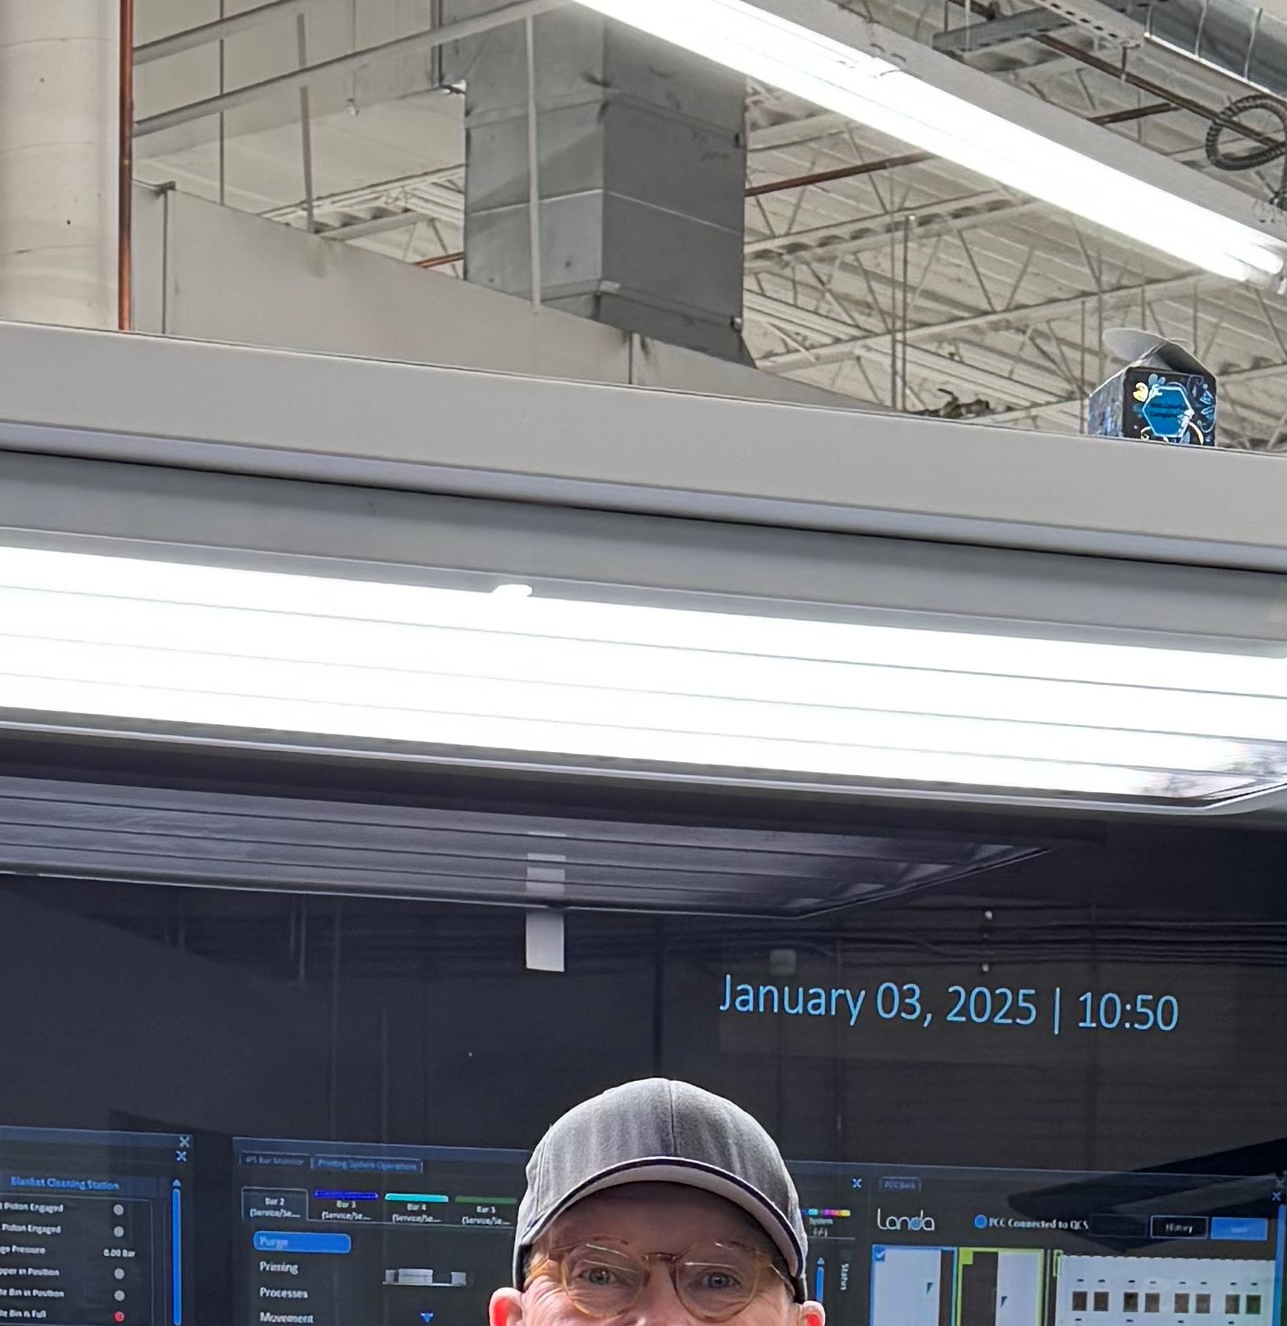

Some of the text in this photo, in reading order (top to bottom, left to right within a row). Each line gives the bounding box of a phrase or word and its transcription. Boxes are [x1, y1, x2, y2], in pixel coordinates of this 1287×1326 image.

[719, 975, 866, 1026] January
[876, 982, 933, 1028] 03,
[946, 986, 1038, 1026] 2025
[1078, 992, 1180, 1032] 10:50
[11, 1176, 119, 1191] Blanket Cleaning Station
[877, 1208, 935, 1231] Landa
[1008, 1218, 1056, 1230] Connected
[1057, 1220, 1068, 1230] to
[1069, 1219, 1089, 1231] QCS
[12, 1245, 46, 1254] Pressure
[27, 1267, 60, 1277] Position
[259, 1261, 298, 1275] Priming
[259, 1287, 308, 1299] Processes
[259, 1312, 314, 1323] Movement
